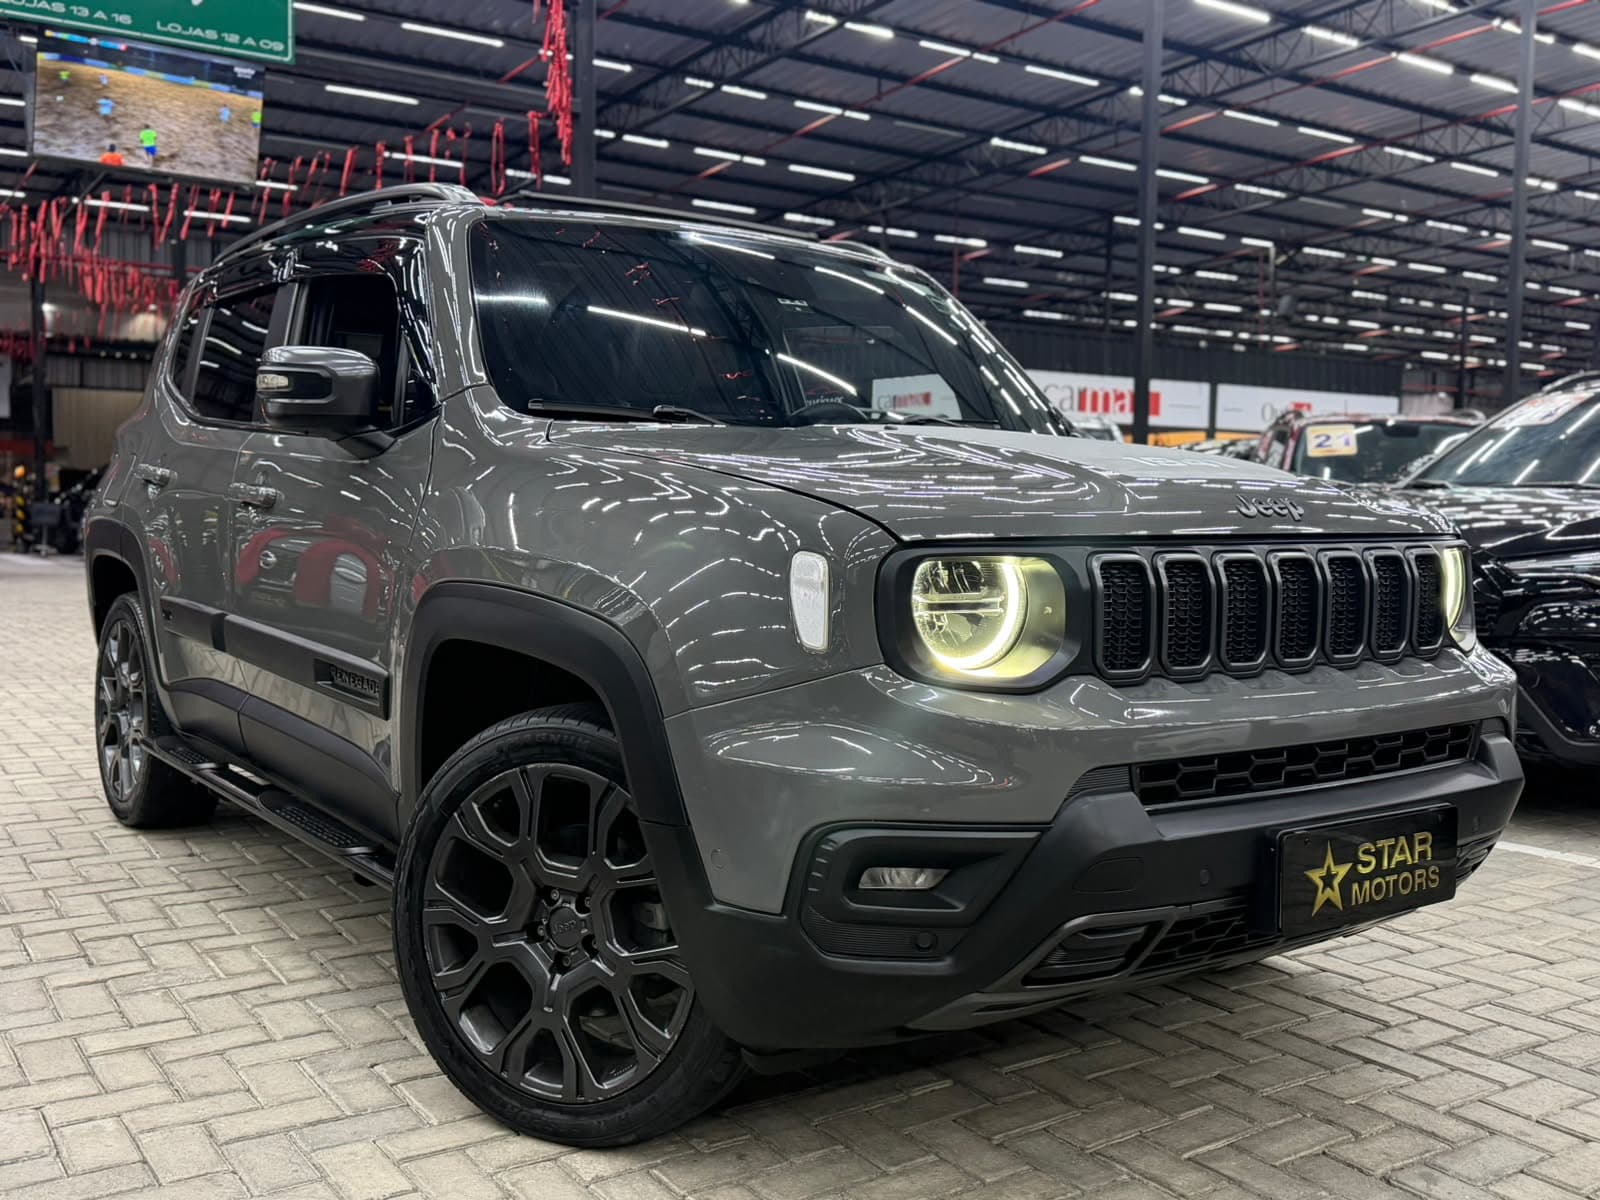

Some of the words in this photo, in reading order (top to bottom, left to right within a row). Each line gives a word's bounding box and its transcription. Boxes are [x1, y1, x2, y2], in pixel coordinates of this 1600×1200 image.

[0, 0, 66, 13] OJAS
[69, 6, 89, 17] 13
[94, 10, 108, 20] A
[111, 13, 132, 25] 16
[156, 20, 218, 40] LOJAS
[221, 32, 240, 44] 12
[243, 36, 257, 47] A
[1235, 493, 1305, 522] Jeep
[1356, 831, 1434, 875] STAR
[1351, 865, 1441, 906] MOTORS
